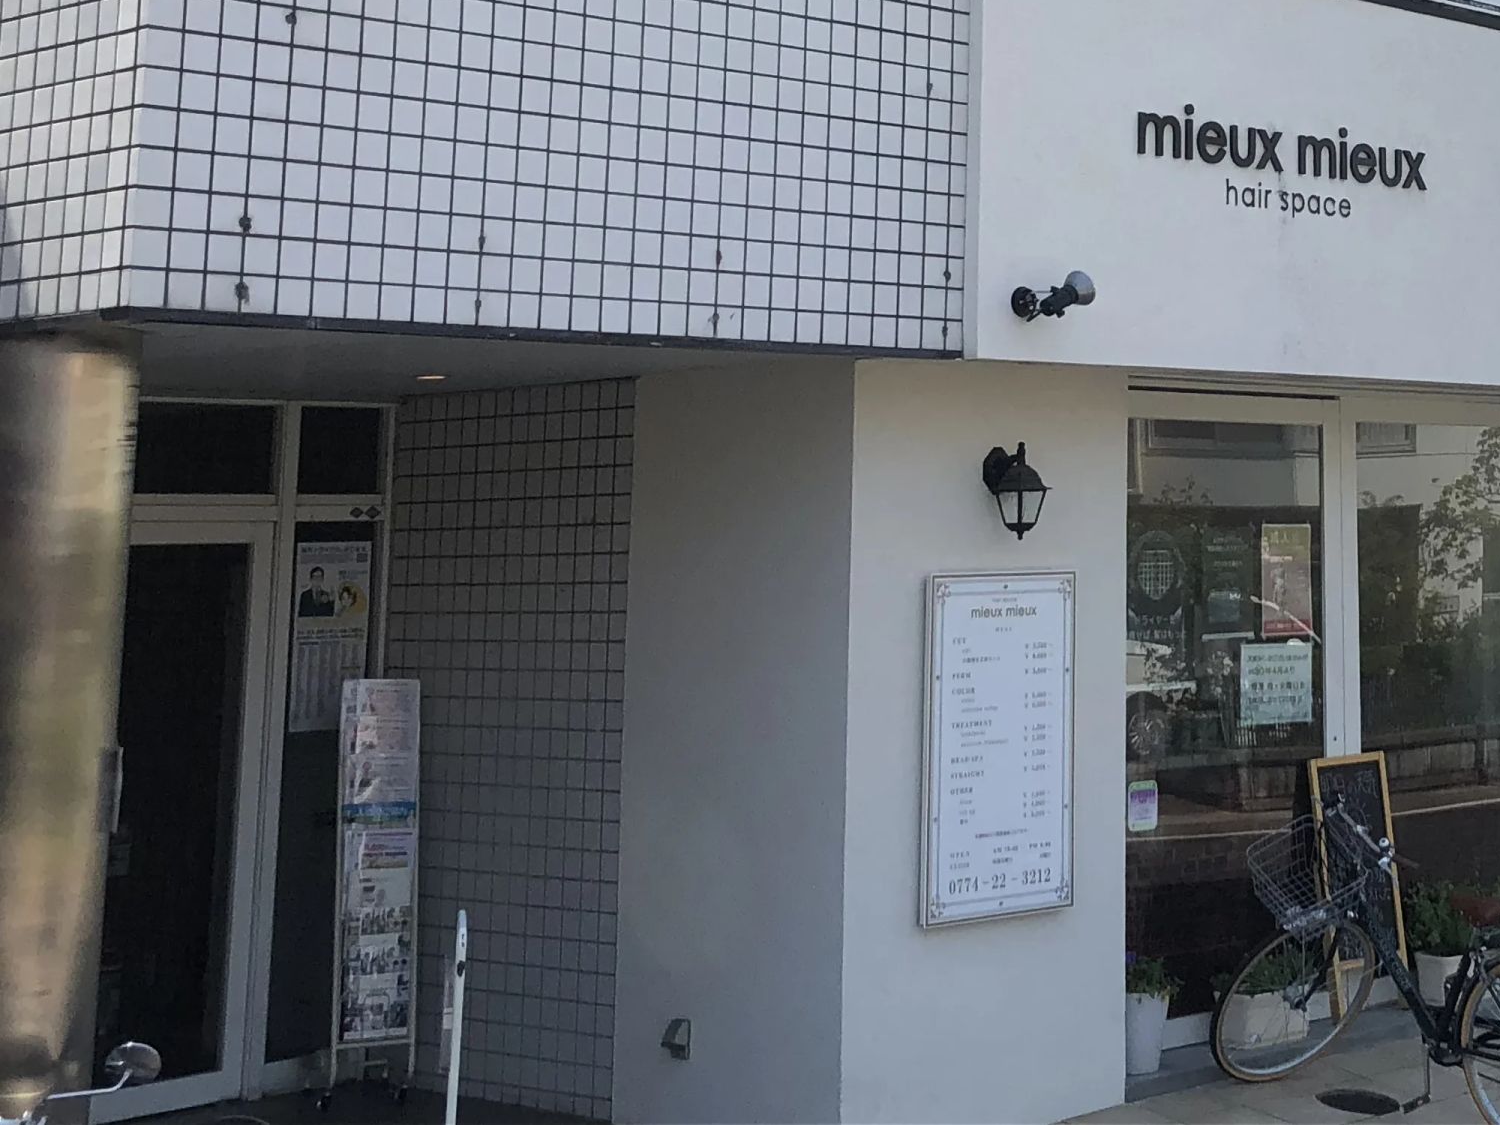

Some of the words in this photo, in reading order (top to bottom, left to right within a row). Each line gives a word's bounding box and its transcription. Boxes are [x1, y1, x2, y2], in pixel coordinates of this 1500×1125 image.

[1137, 103, 1284, 172] mieux
[1297, 127, 1427, 191] mieux
[1226, 178, 1272, 209] hair
[1279, 189, 1351, 218] space
[971, 606, 1003, 619] mieux
[1005, 604, 1037, 617] mieux
